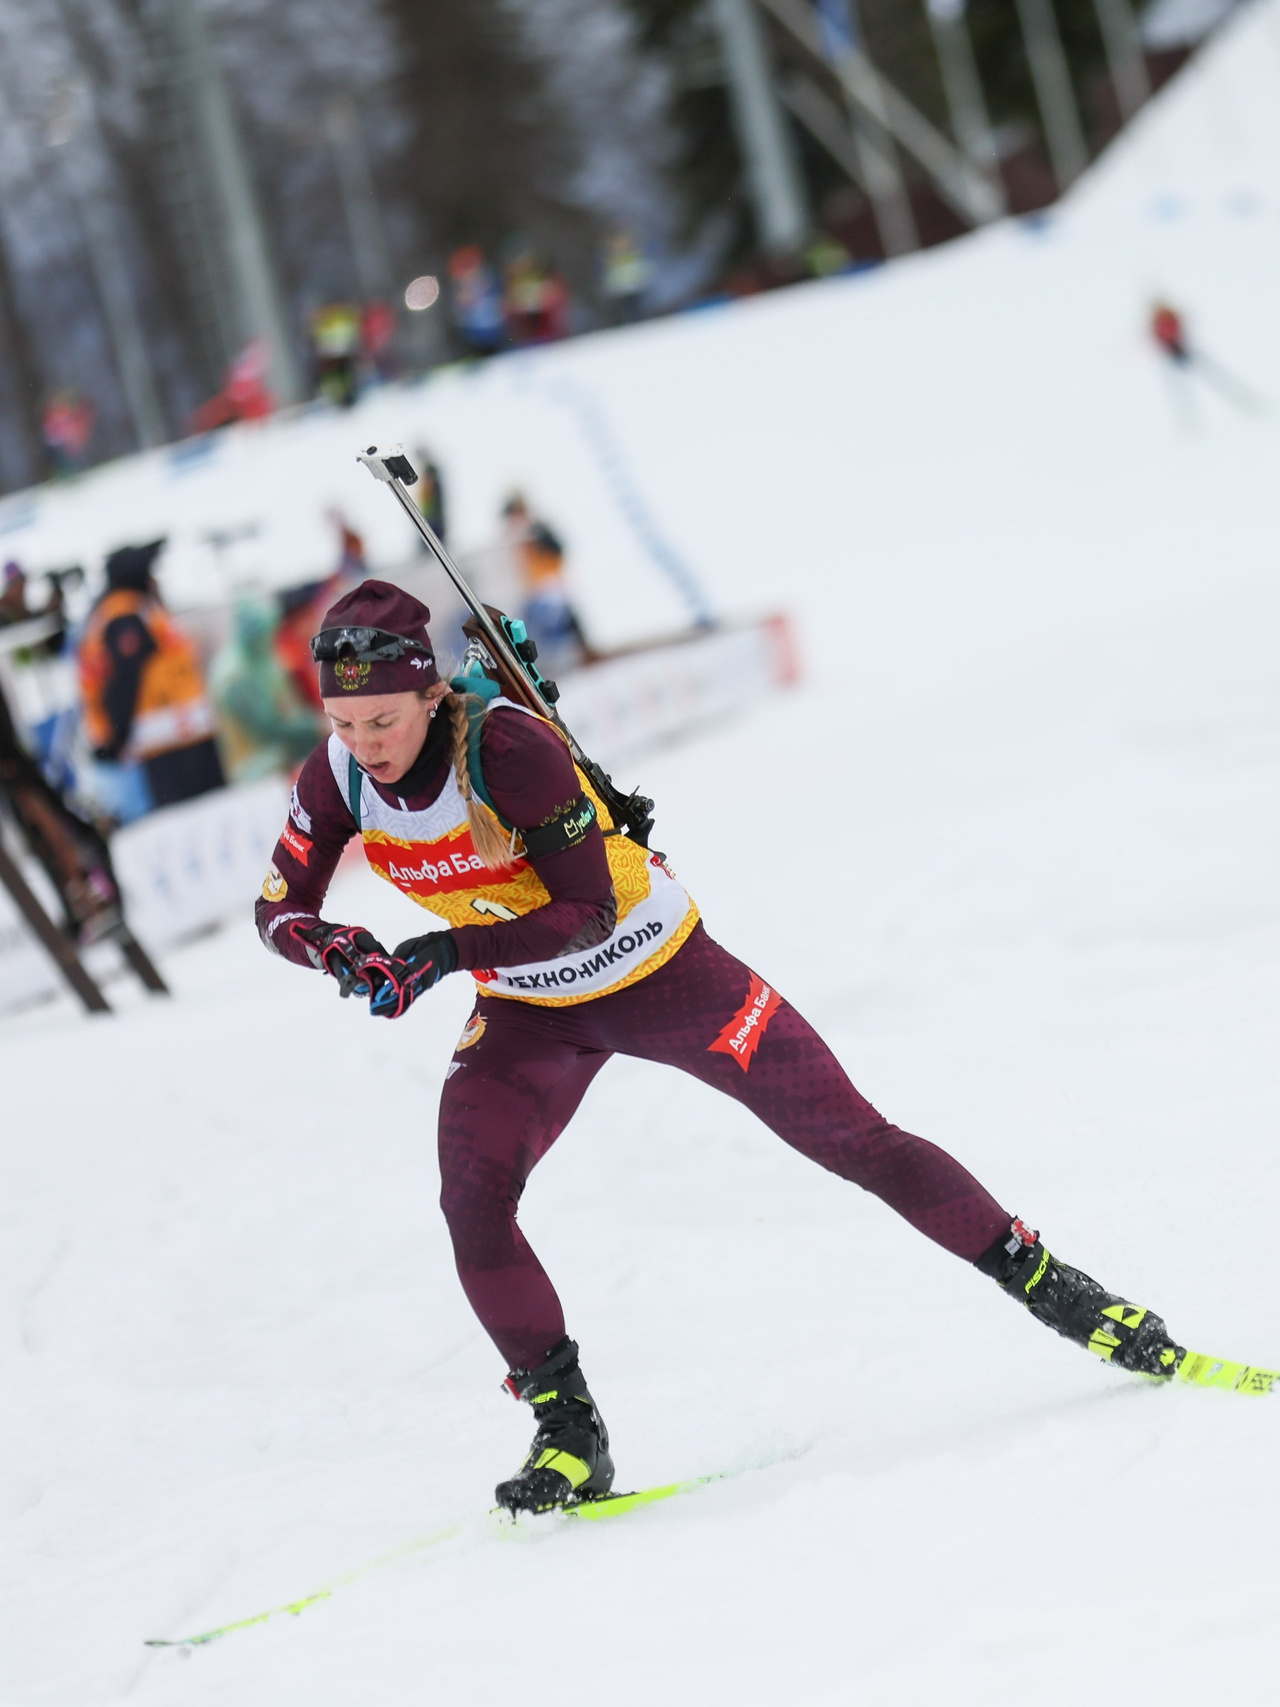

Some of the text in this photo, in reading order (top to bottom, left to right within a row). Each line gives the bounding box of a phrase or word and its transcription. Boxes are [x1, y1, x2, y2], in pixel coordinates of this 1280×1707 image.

[388, 853, 486, 887] Альфа Ба
[728, 984, 771, 1055] Альфа Банк
[1024, 1248, 1051, 1294] FISCHE
